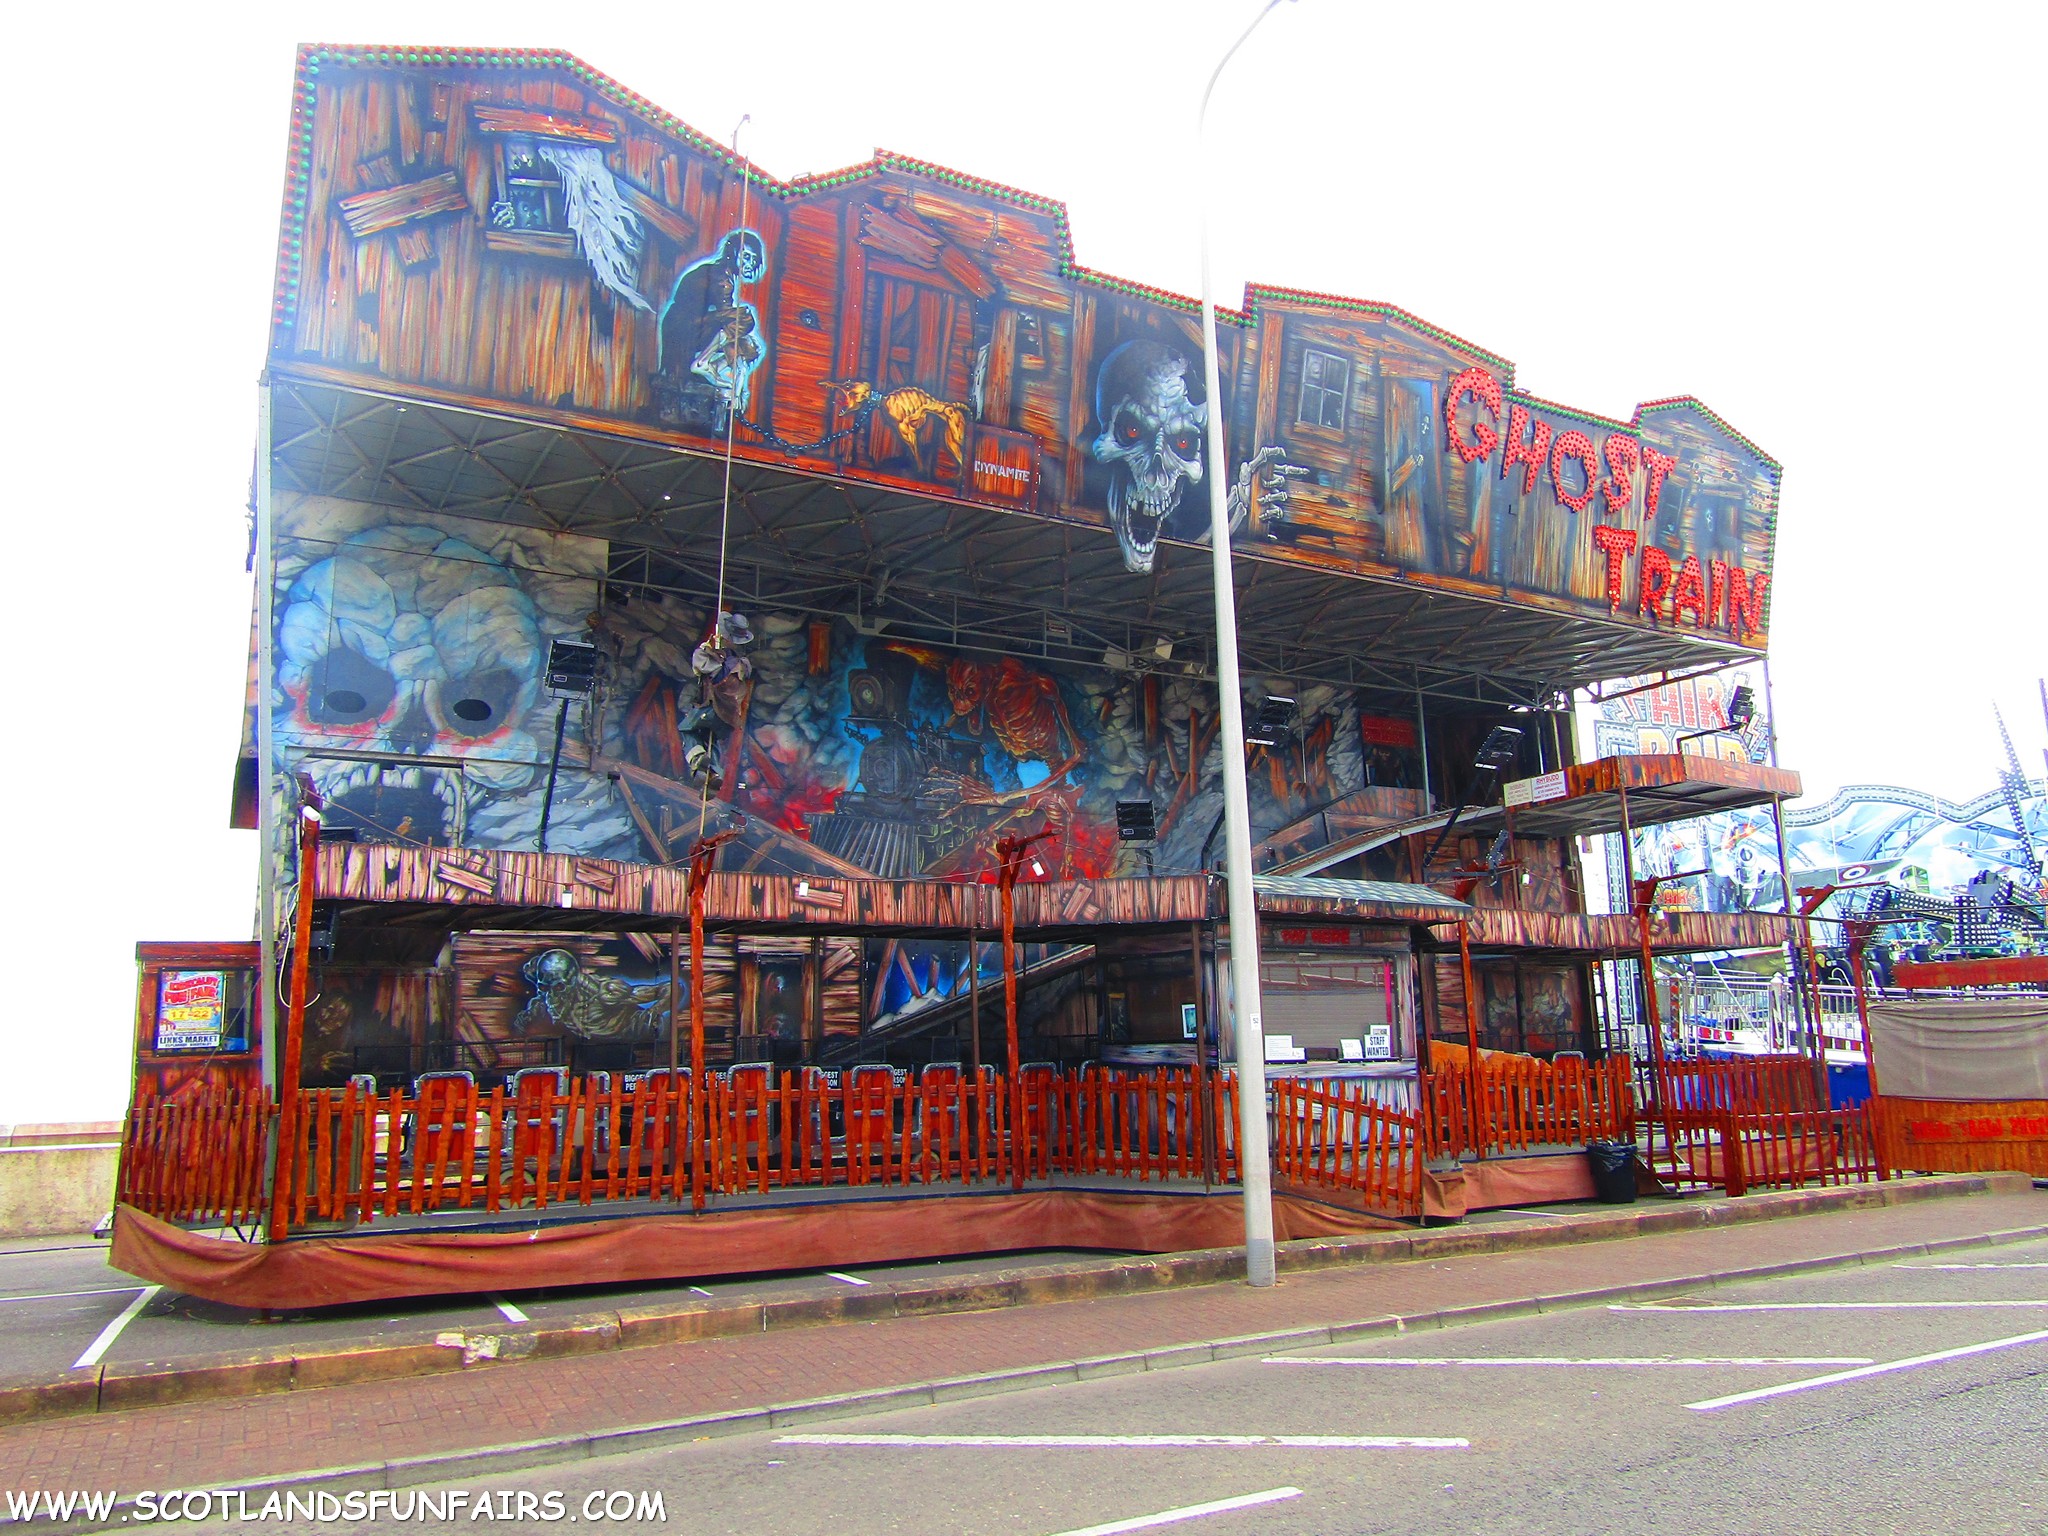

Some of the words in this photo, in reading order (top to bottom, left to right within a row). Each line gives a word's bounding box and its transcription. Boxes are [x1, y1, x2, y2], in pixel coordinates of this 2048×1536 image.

[1445, 366, 1676, 521] GHOST
[974, 460, 1030, 482] DYNAMITE
[1595, 524, 1770, 639] TRAIN
[185, 1035, 218, 1043] MARKET
[1369, 1036, 1385, 1046] STAFF
[1367, 1046, 1389, 1056] WANTED
